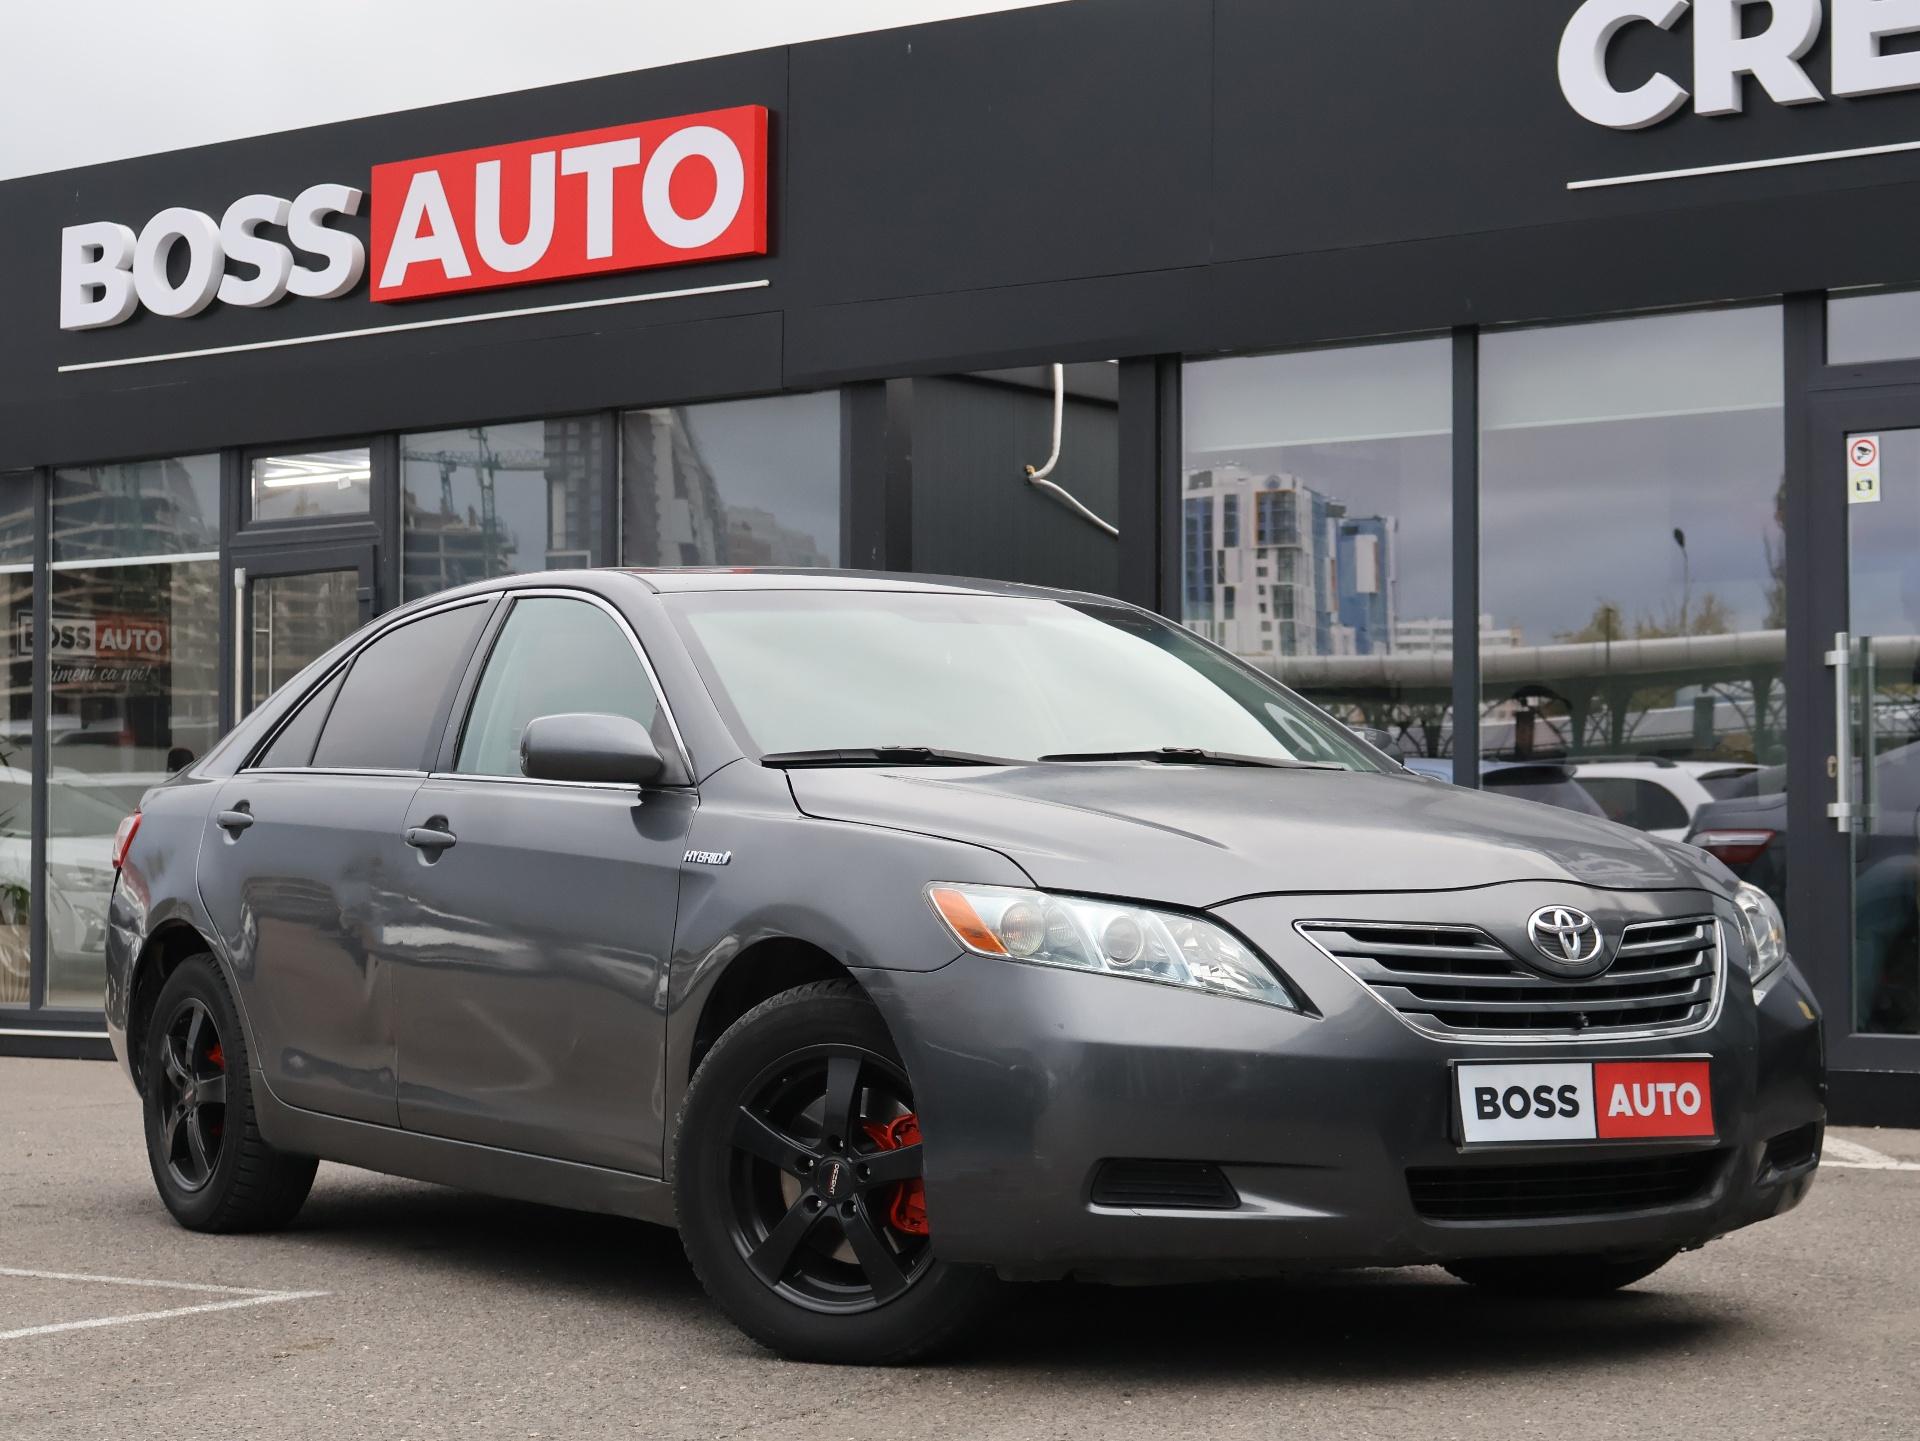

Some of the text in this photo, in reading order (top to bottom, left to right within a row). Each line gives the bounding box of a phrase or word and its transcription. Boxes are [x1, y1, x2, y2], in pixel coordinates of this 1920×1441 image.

[1558, 0, 1920, 130] CRE
[60, 125, 745, 330] BOSS AUTO
[100, 628, 162, 652] AUTO
[51, 664, 97, 682] imeni
[683, 850, 723, 865] HYBRID
[1475, 1082, 1702, 1120] BOSS AUTO
